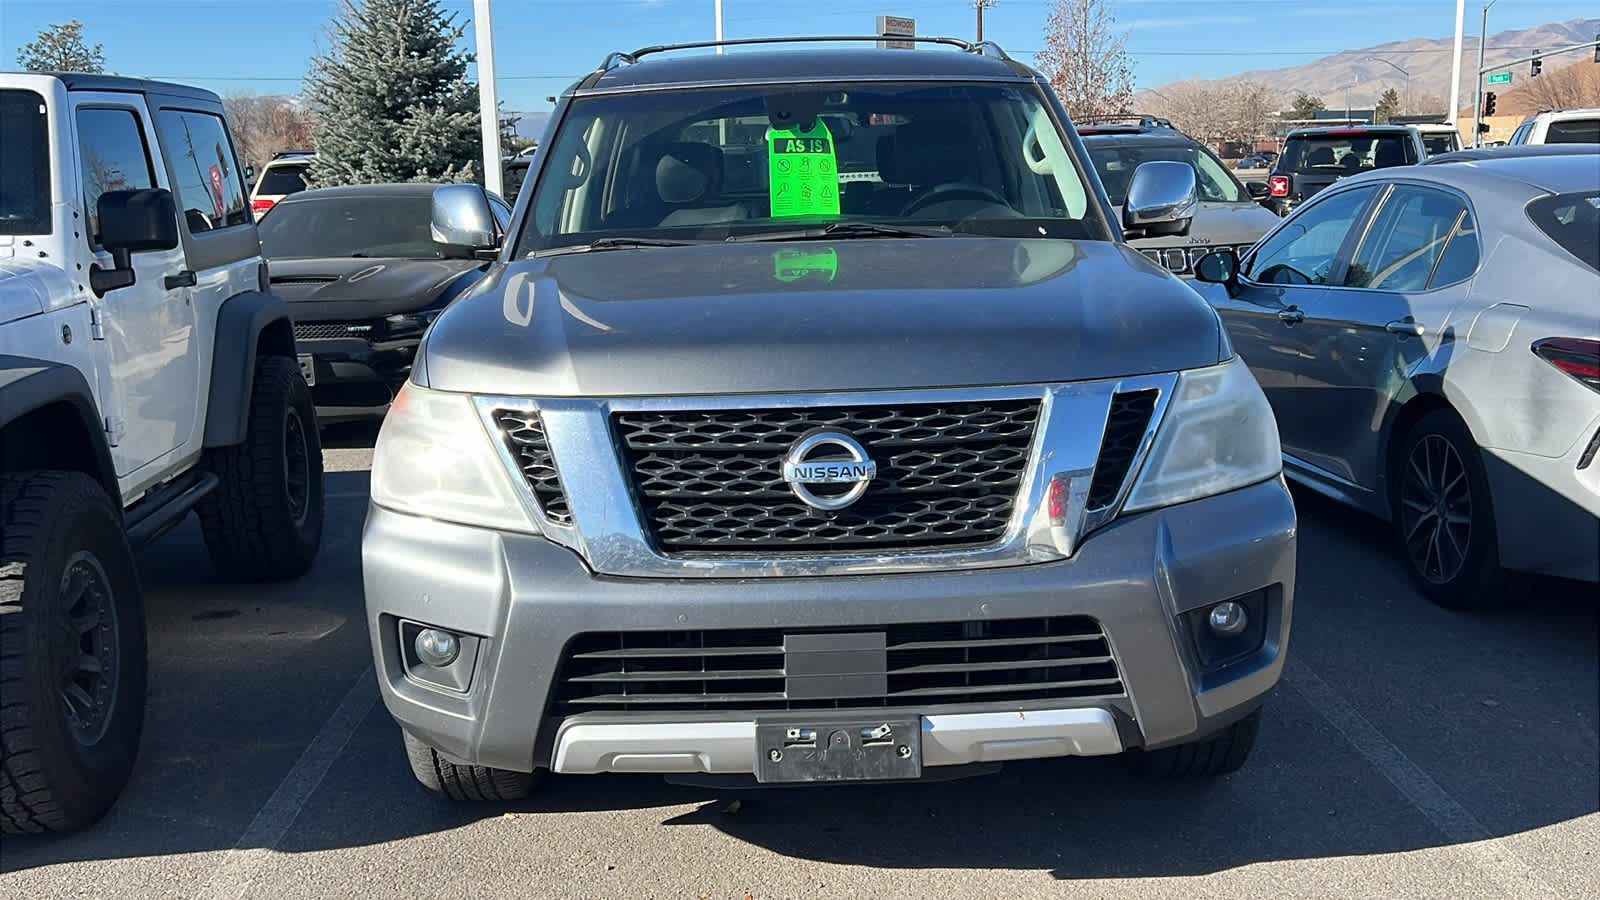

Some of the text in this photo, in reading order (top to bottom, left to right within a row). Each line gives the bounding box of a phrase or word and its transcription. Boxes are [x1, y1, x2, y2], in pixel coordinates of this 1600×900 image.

[786, 139, 823, 152] AS IS
[794, 465, 866, 478] NISSAN
